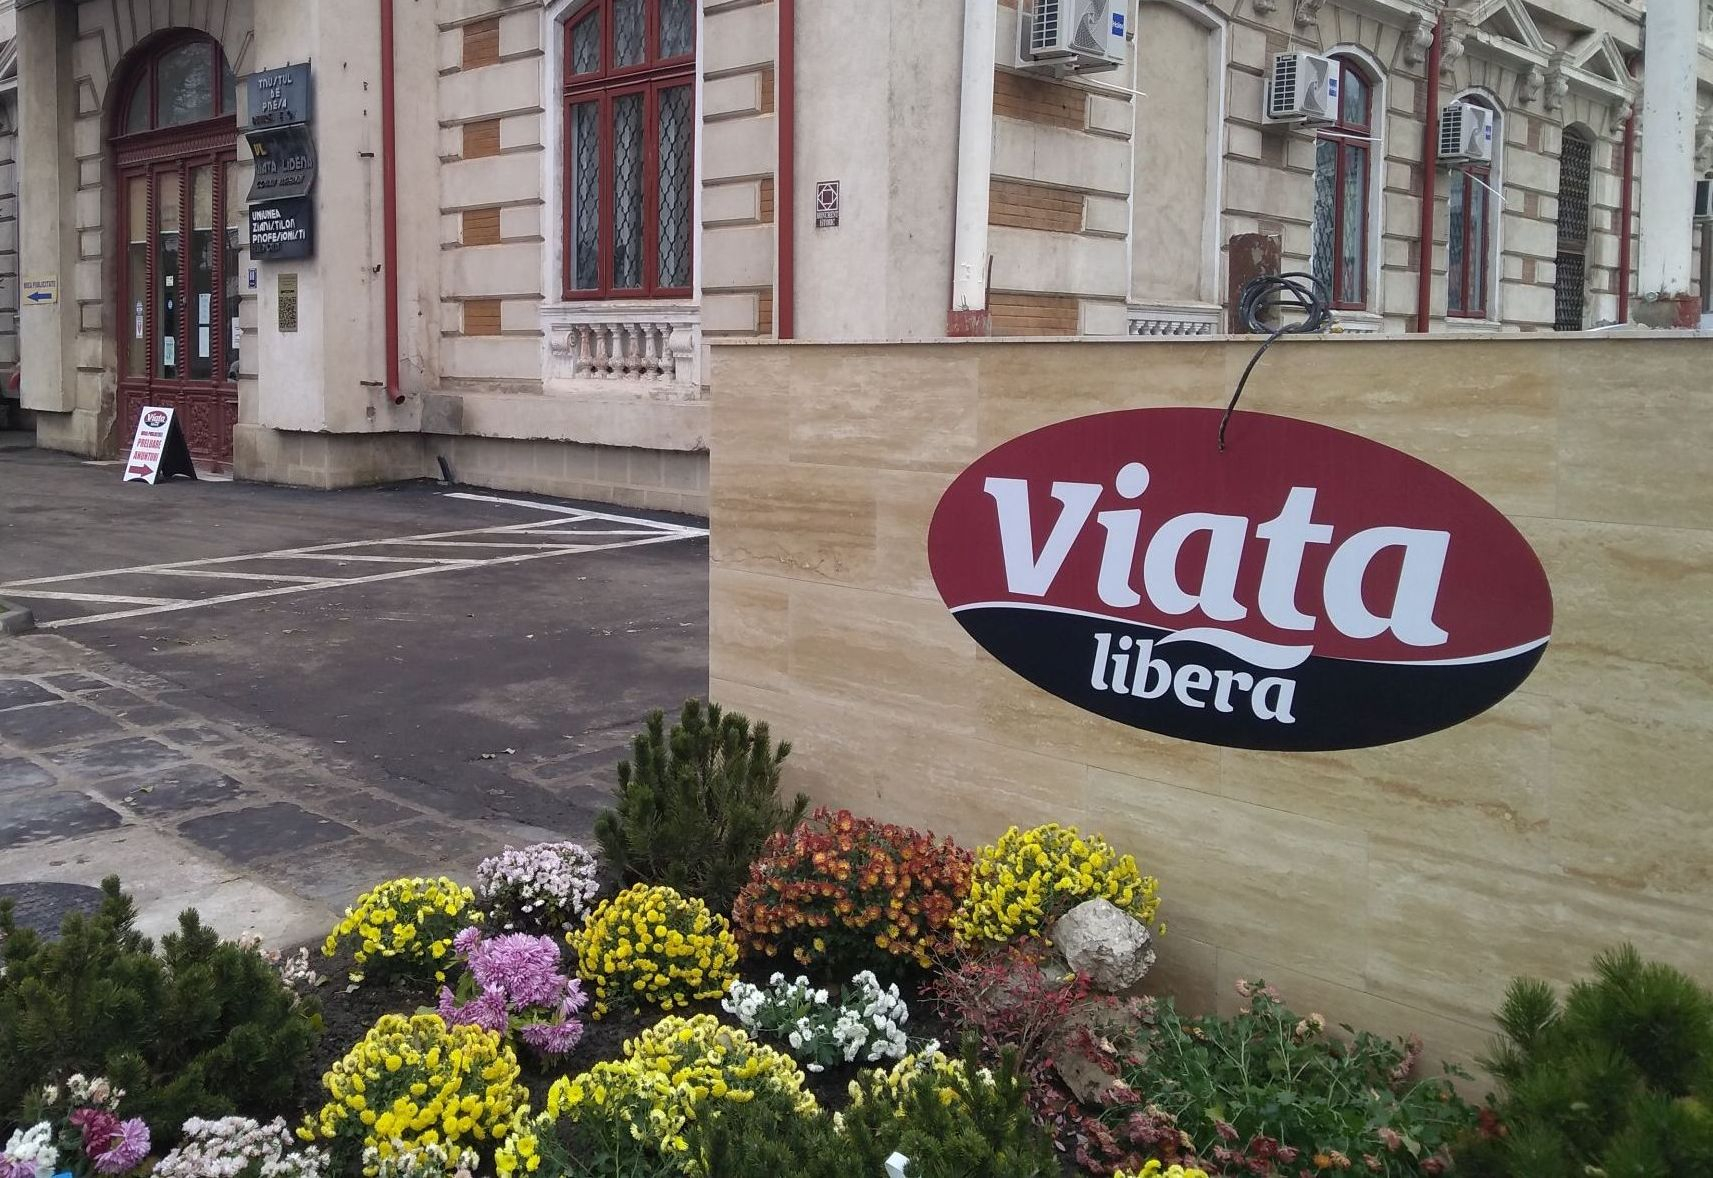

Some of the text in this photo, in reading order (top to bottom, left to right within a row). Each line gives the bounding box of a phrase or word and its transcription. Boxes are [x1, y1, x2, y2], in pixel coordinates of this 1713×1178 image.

[270, 87, 281, 99] DE
[252, 209, 281, 221] UNIUNEA
[984, 461, 1451, 647] Viata
[1090, 632, 1296, 725] libera
